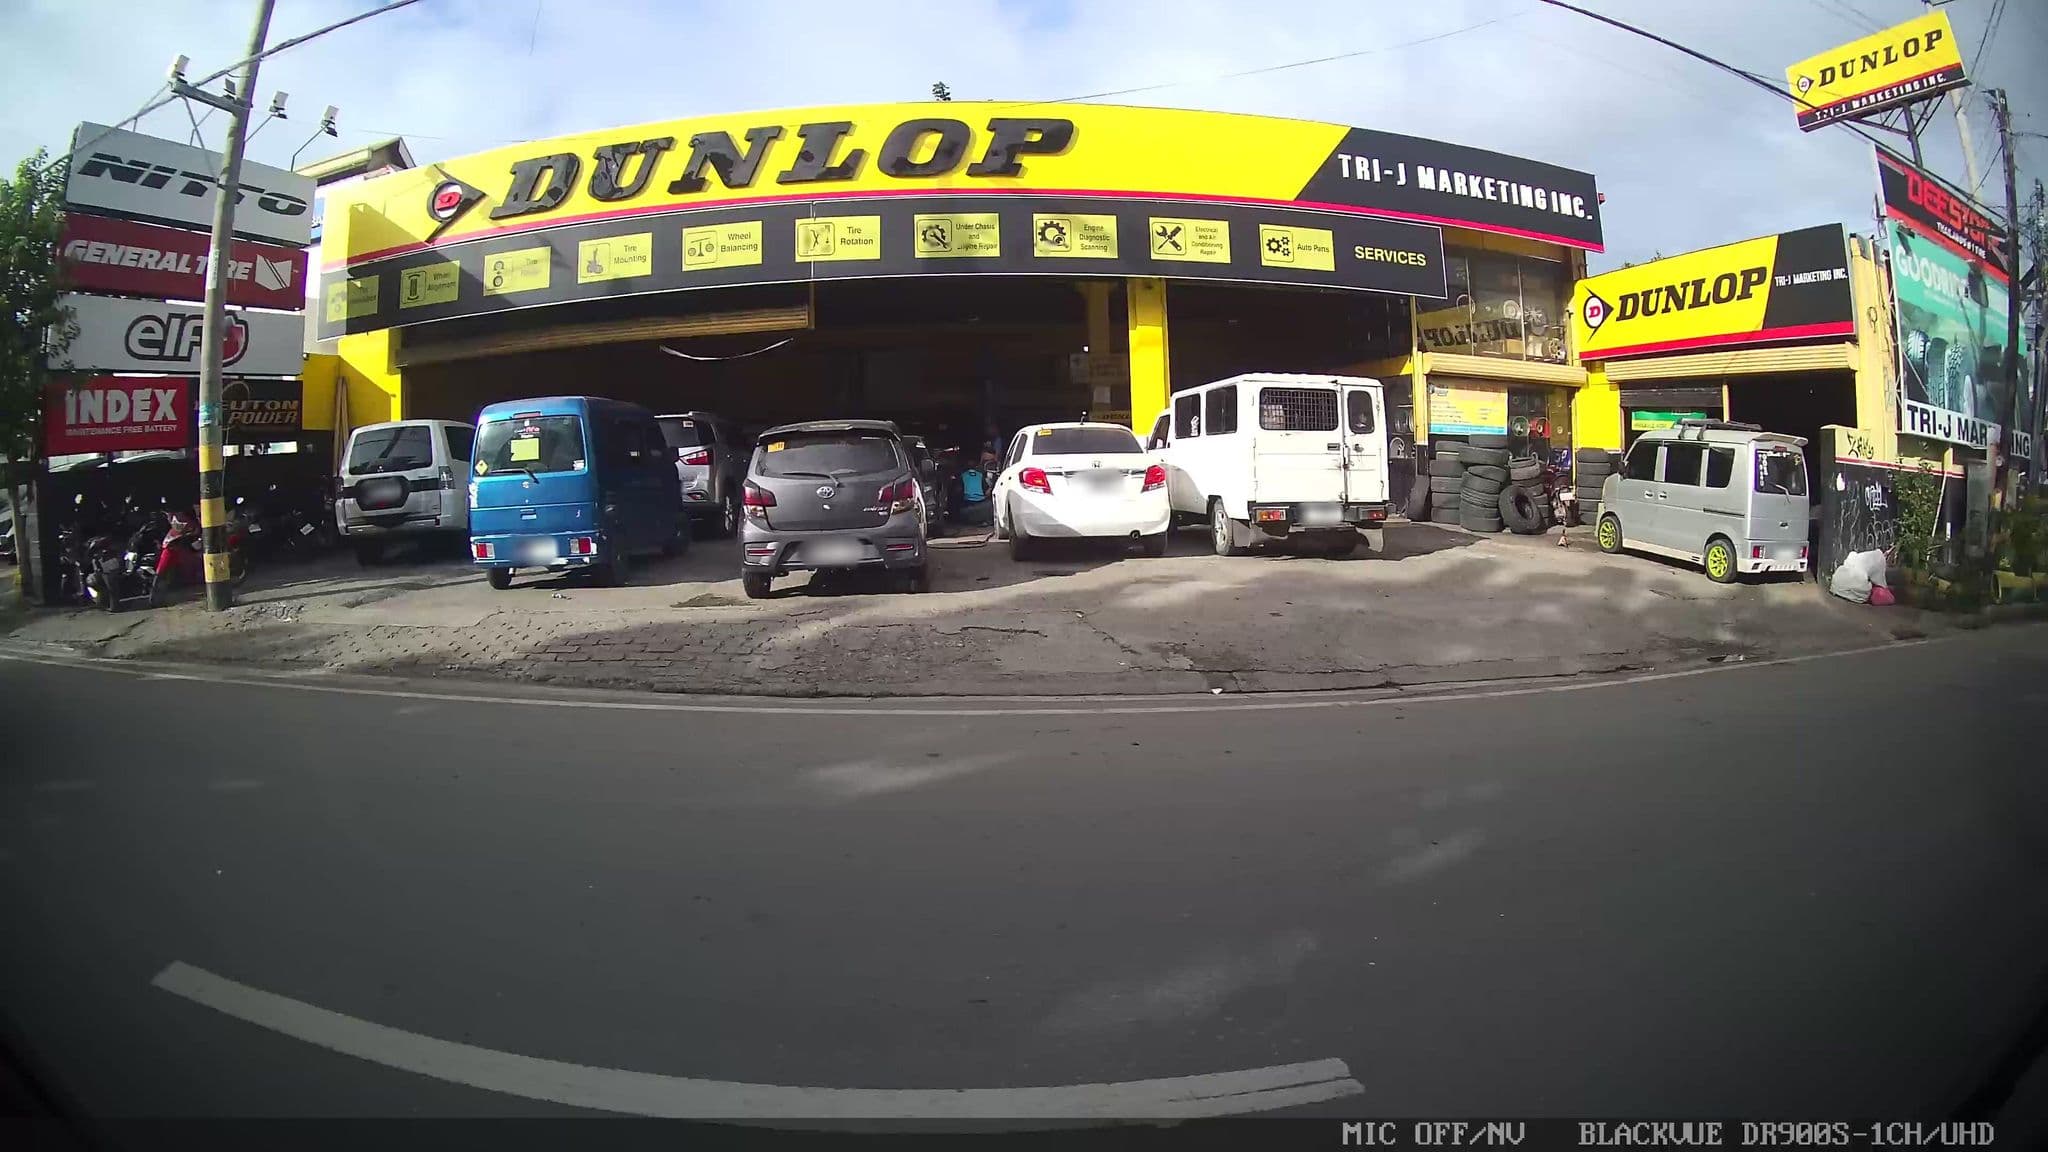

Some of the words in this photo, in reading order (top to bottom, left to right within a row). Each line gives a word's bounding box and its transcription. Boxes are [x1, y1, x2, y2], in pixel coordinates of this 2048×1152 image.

[1818, 28, 1942, 88] DUNLOP
[1852, 80, 1920, 108] MARKETING
[1922, 73, 1946, 87] INC.
[489, 117, 1076, 220] DUNLOP
[1337, 153, 1407, 186] TRI-J
[1416, 165, 1547, 210] MARKETING
[1550, 191, 1593, 220] INC.
[1083, 224, 1104, 232] Engine
[727, 232, 751, 241] Wheel
[1079, 234, 1110, 242] Diagnostic
[624, 244, 637, 253] Tire
[720, 243, 758, 253] Balancing
[957, 243, 977, 251] ngine
[1080, 244, 1108, 252] Scanning
[1297, 243, 1312, 251] Auto
[1313, 244, 1330, 253] Parts
[64, 239, 191, 274] GENERAL
[196, 255, 253, 280] TRE
[613, 254, 647, 265] Mounting
[1354, 245, 1427, 267] SERVICES
[1774, 275, 1791, 287] TRI-J
[1793, 269, 1832, 284] MARKETING
[1833, 268, 1848, 280] INC.
[1616, 266, 1768, 322] DUNLOP
[65, 388, 178, 425] INDEX
[194, 399, 298, 411] UTON
[228, 411, 297, 424] POWER
[123, 426, 143, 434] FREE
[144, 424, 178, 433] BATTERY
[1907, 404, 1952, 438] TRI-J
[1957, 417, 2030, 457] MARING
